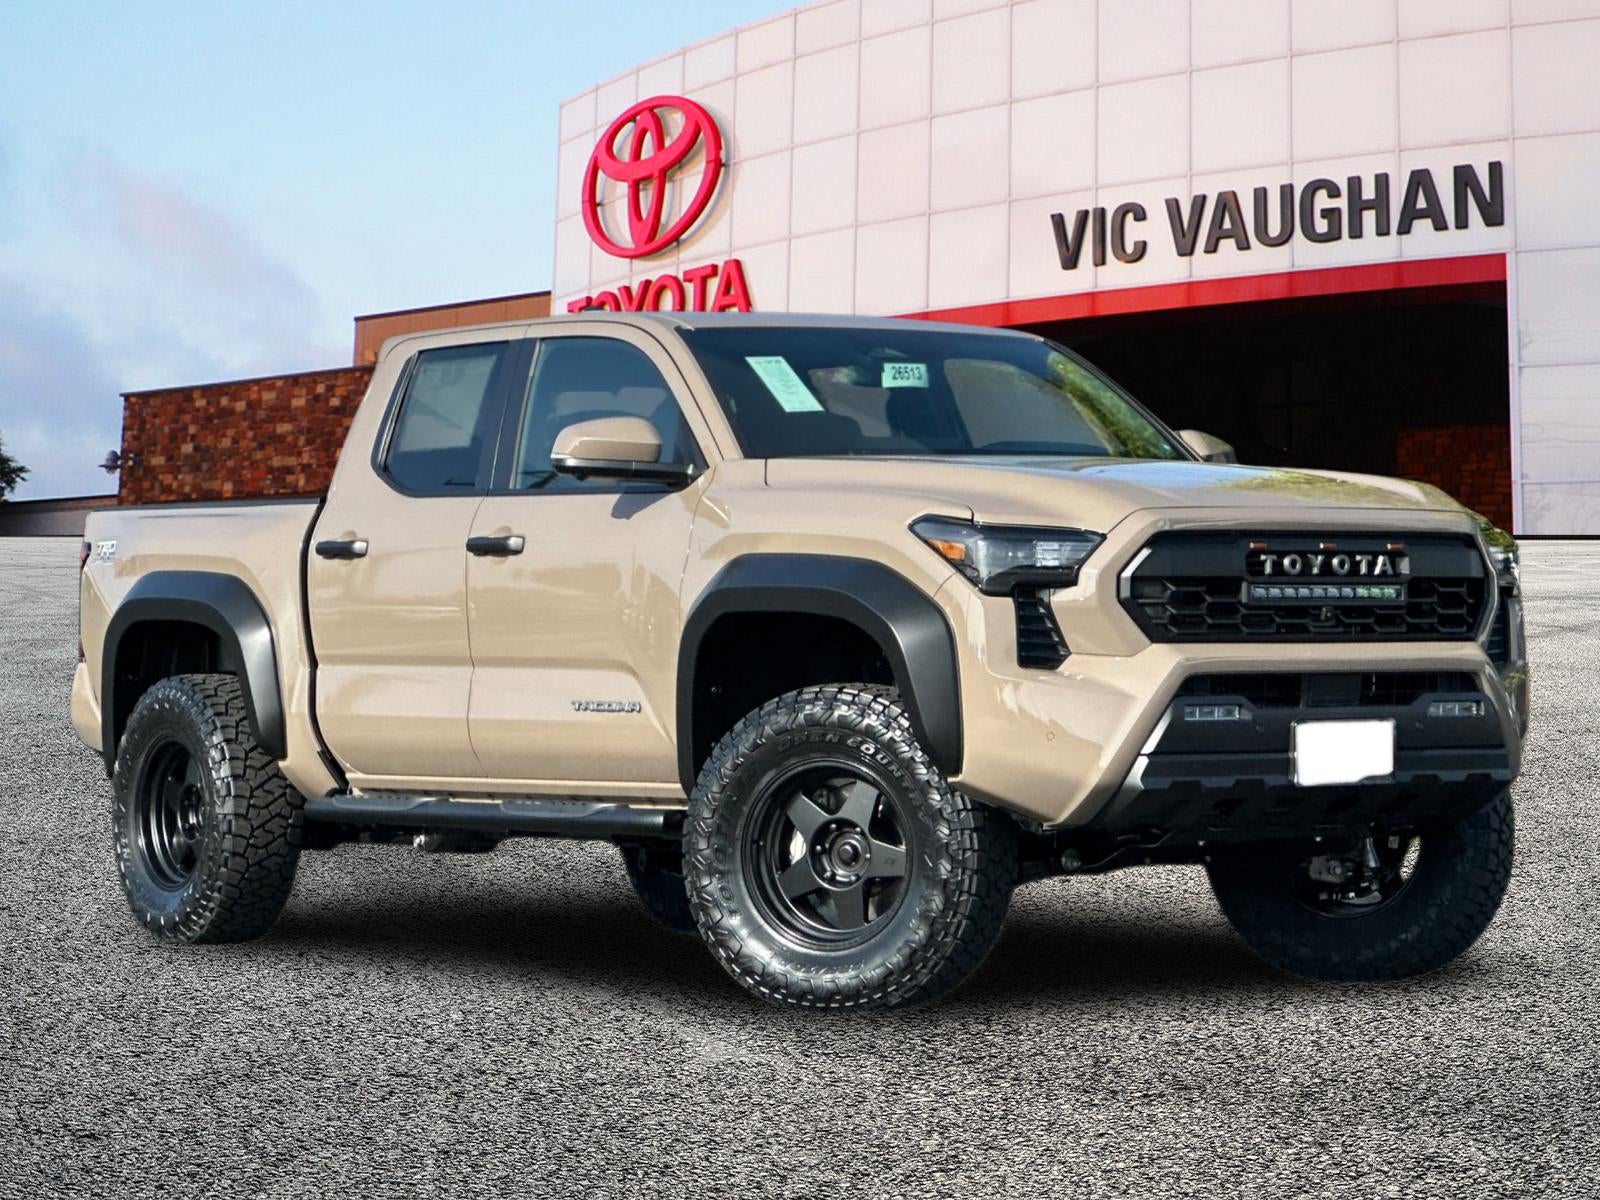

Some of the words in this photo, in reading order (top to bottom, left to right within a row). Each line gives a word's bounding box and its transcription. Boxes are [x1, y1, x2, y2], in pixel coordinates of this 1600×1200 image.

[1050, 201, 1148, 271] VIC
[1164, 160, 1505, 258] VAUGHAN
[567, 258, 753, 312] YOTA
[891, 365, 923, 381] 26513
[1260, 553, 1394, 576] TOYOTA
